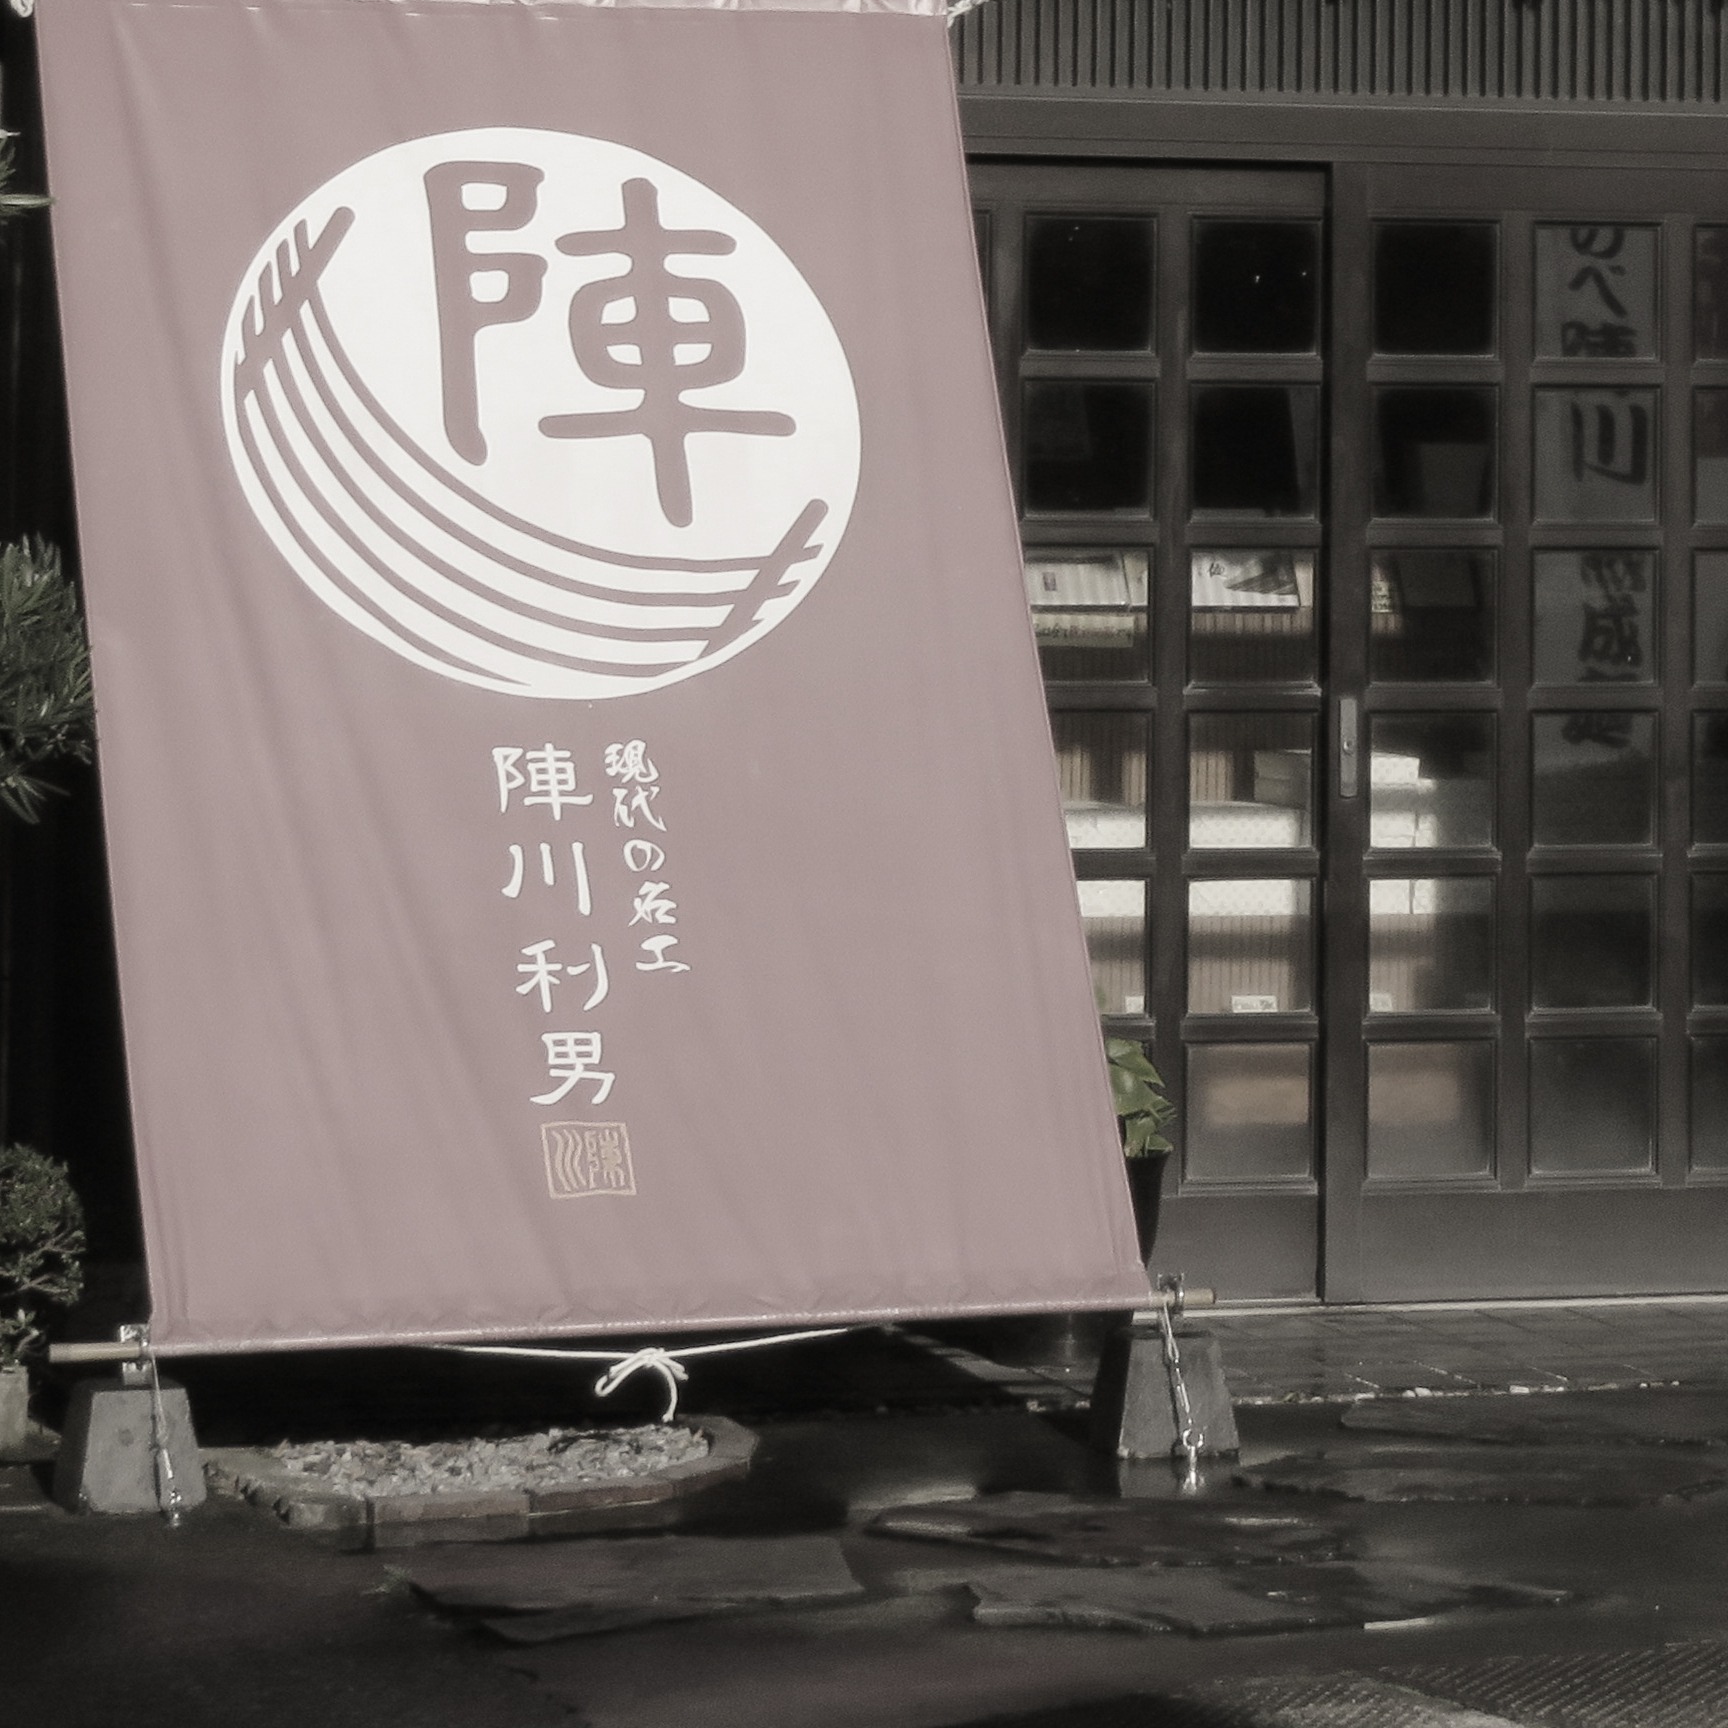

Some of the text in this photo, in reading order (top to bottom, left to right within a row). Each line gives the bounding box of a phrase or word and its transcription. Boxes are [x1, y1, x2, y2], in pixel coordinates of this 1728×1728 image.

[423, 160, 797, 529] 陣
[492, 742, 616, 1105] 陣川利男
